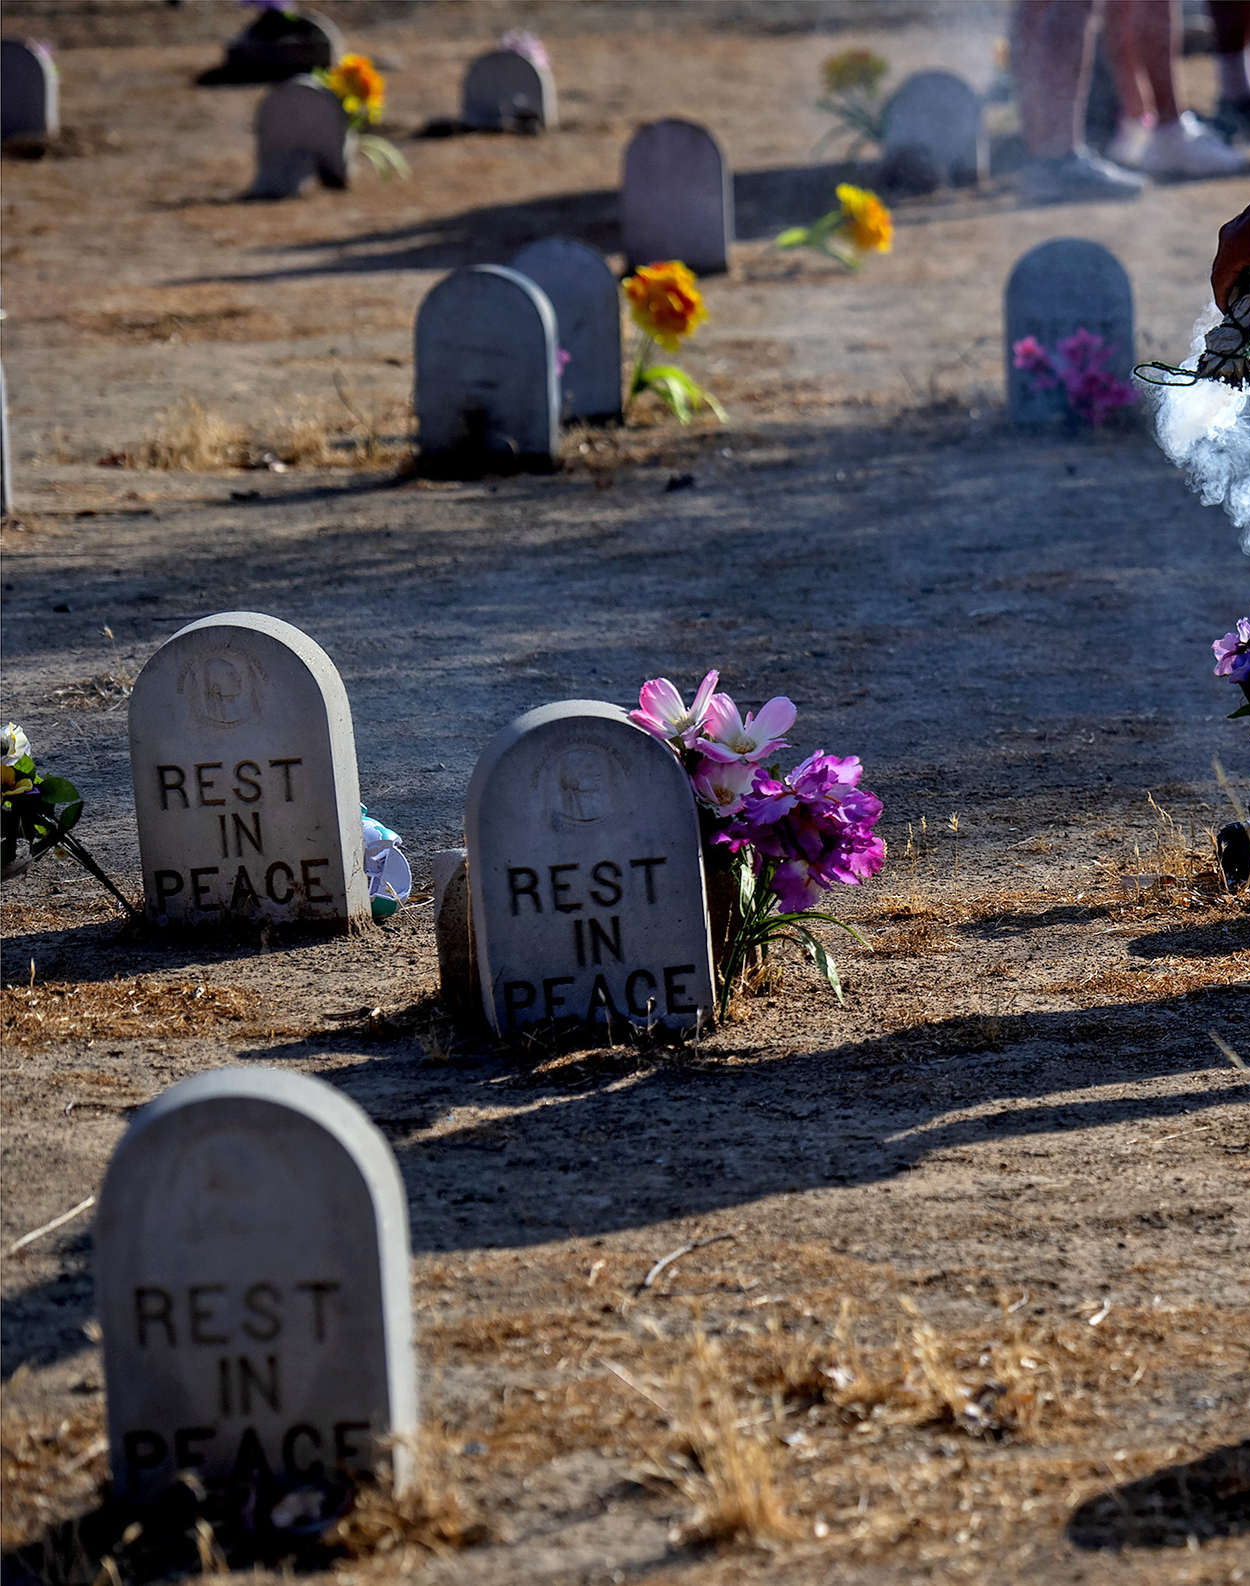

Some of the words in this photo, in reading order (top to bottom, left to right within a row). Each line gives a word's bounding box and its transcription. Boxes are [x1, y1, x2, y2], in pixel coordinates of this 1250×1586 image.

[156, 757, 303, 811] REST
[218, 811, 264, 858] IN
[153, 858, 334, 914] PEACE
[506, 856, 668, 917] REST
[573, 916, 626, 967] IN
[503, 964, 699, 1028] PEACE
[132, 1280, 342, 1348] REST
[216, 1354, 281, 1415] IN
[123, 1421, 374, 1494] PEACE
